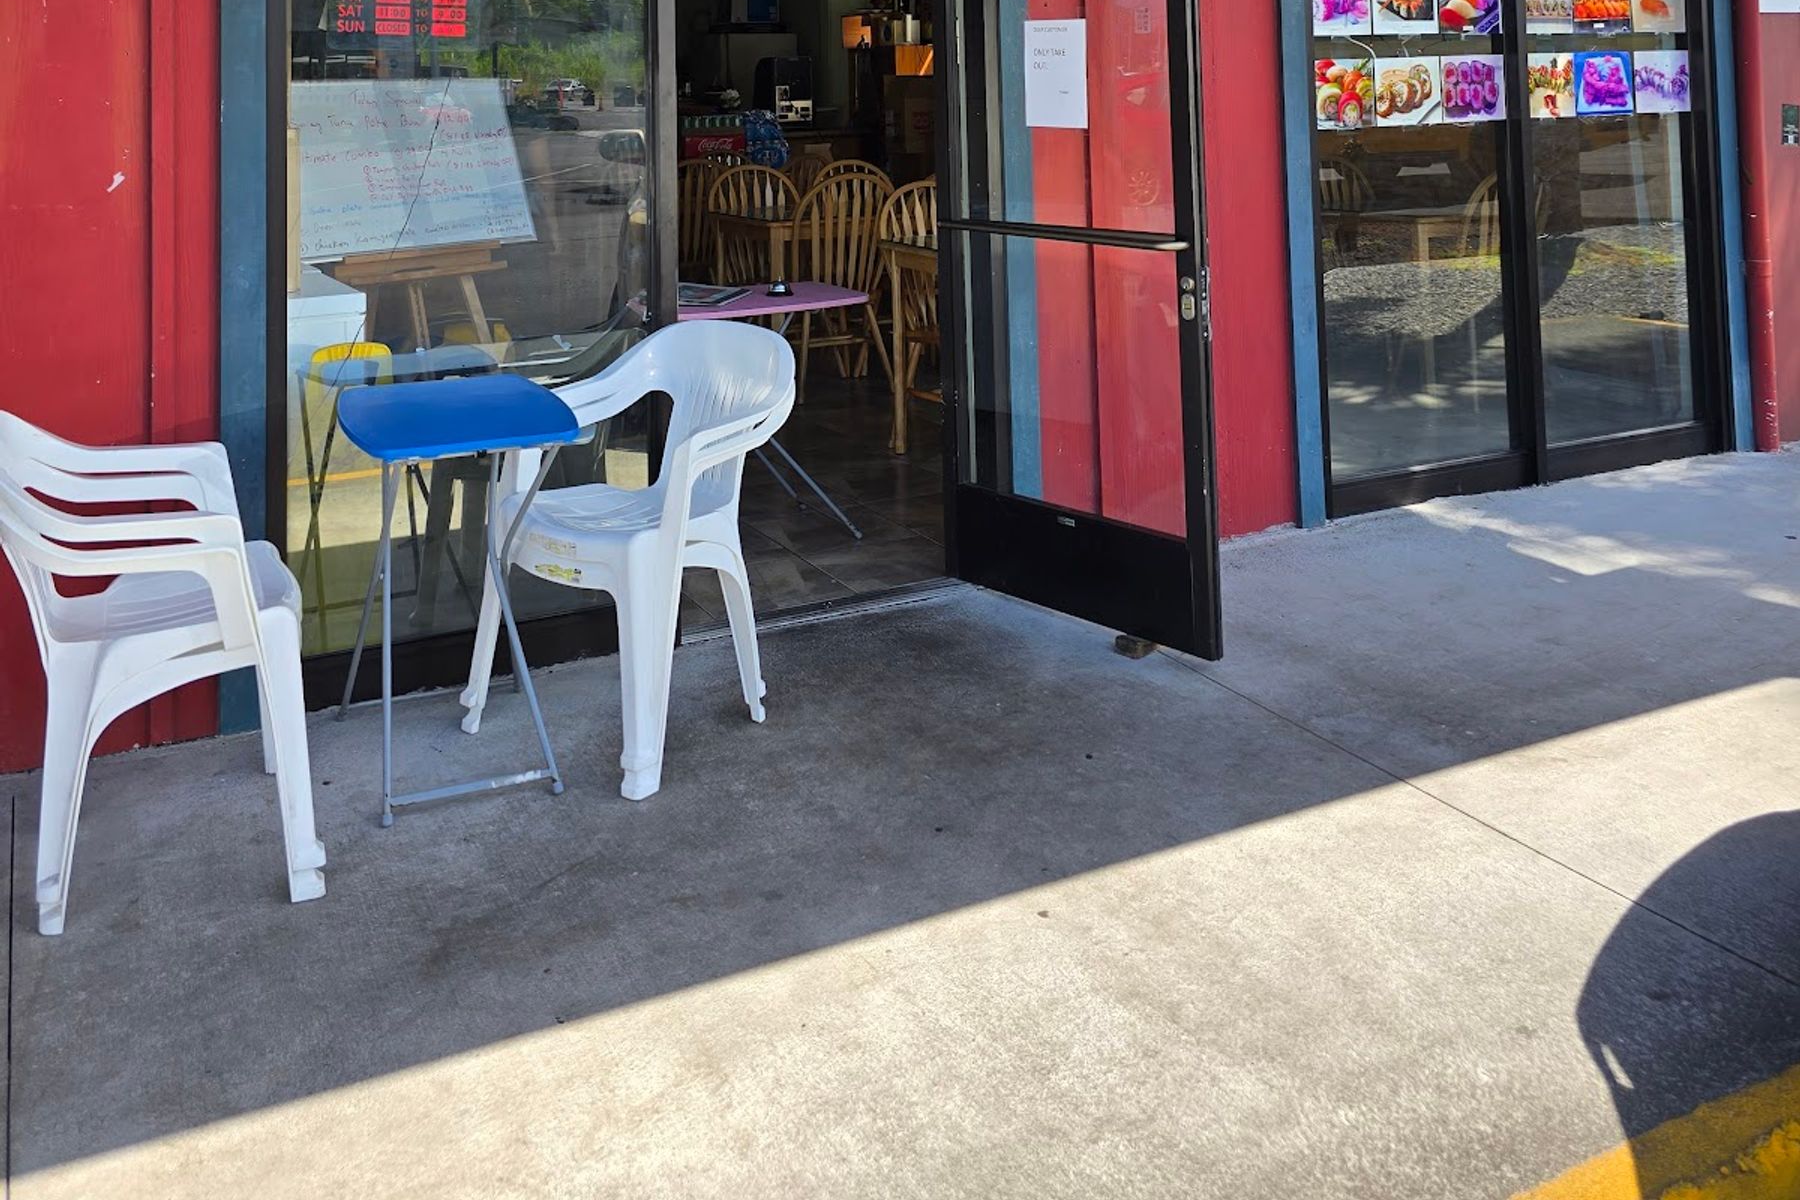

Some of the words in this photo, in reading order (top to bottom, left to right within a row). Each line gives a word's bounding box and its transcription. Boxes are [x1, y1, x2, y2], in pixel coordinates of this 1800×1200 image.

[338, 4, 364, 17] SAT
[416, 9, 428, 18] TO
[337, 19, 365, 33] SUN
[377, 23, 408, 33] CLOSED
[415, 24, 428, 33] TO
